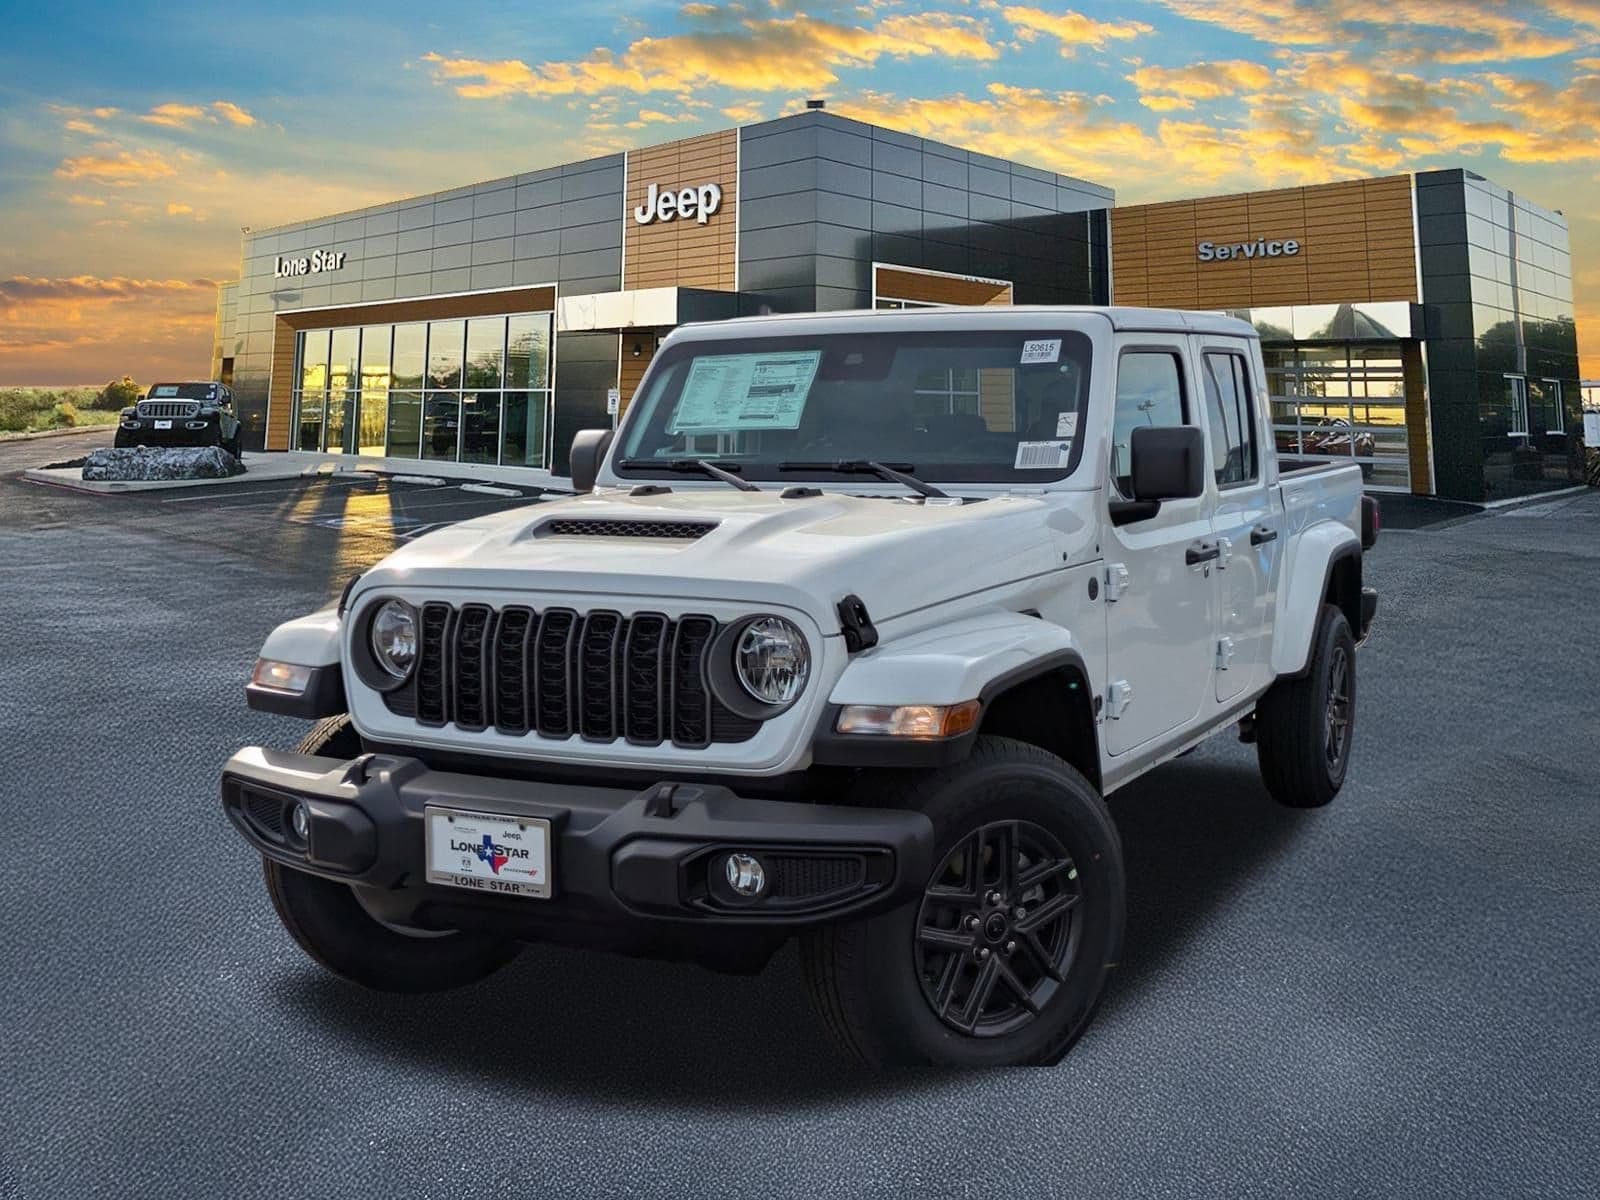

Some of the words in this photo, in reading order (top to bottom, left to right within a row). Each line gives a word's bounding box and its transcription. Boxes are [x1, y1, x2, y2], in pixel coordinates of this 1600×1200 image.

[634, 182, 722, 225] Jeep
[1198, 236, 1300, 261] Service
[274, 256, 311, 278] Lone
[311, 249, 347, 273] Star
[450, 839, 484, 854] LONE
[494, 844, 529, 859] STAR
